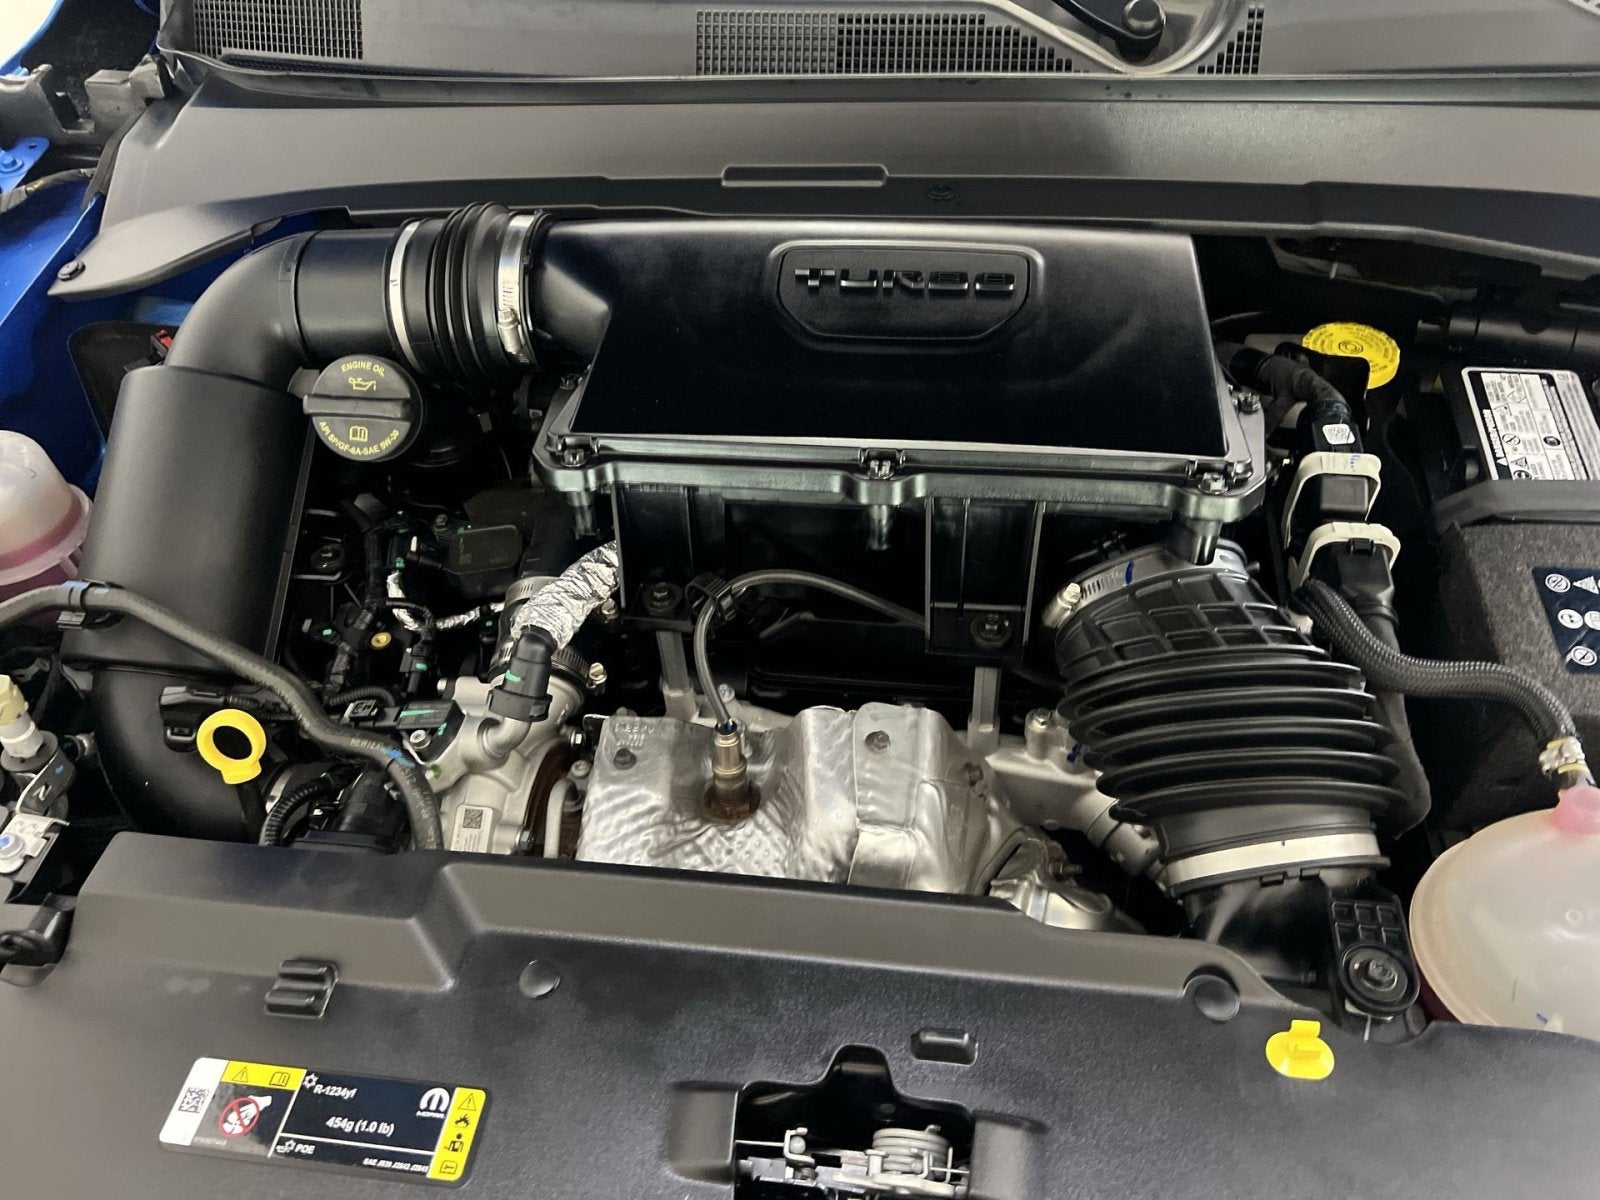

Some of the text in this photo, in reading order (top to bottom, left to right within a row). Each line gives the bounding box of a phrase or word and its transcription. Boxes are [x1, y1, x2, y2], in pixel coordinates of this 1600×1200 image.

[341, 360, 385, 377] ENGINE OIL
[319, 421, 331, 435] API
[379, 429, 400, 450] 5W-30
[325, 1116, 395, 1138] 454g (1.0 lb)
[294, 1143, 316, 1155] POE
